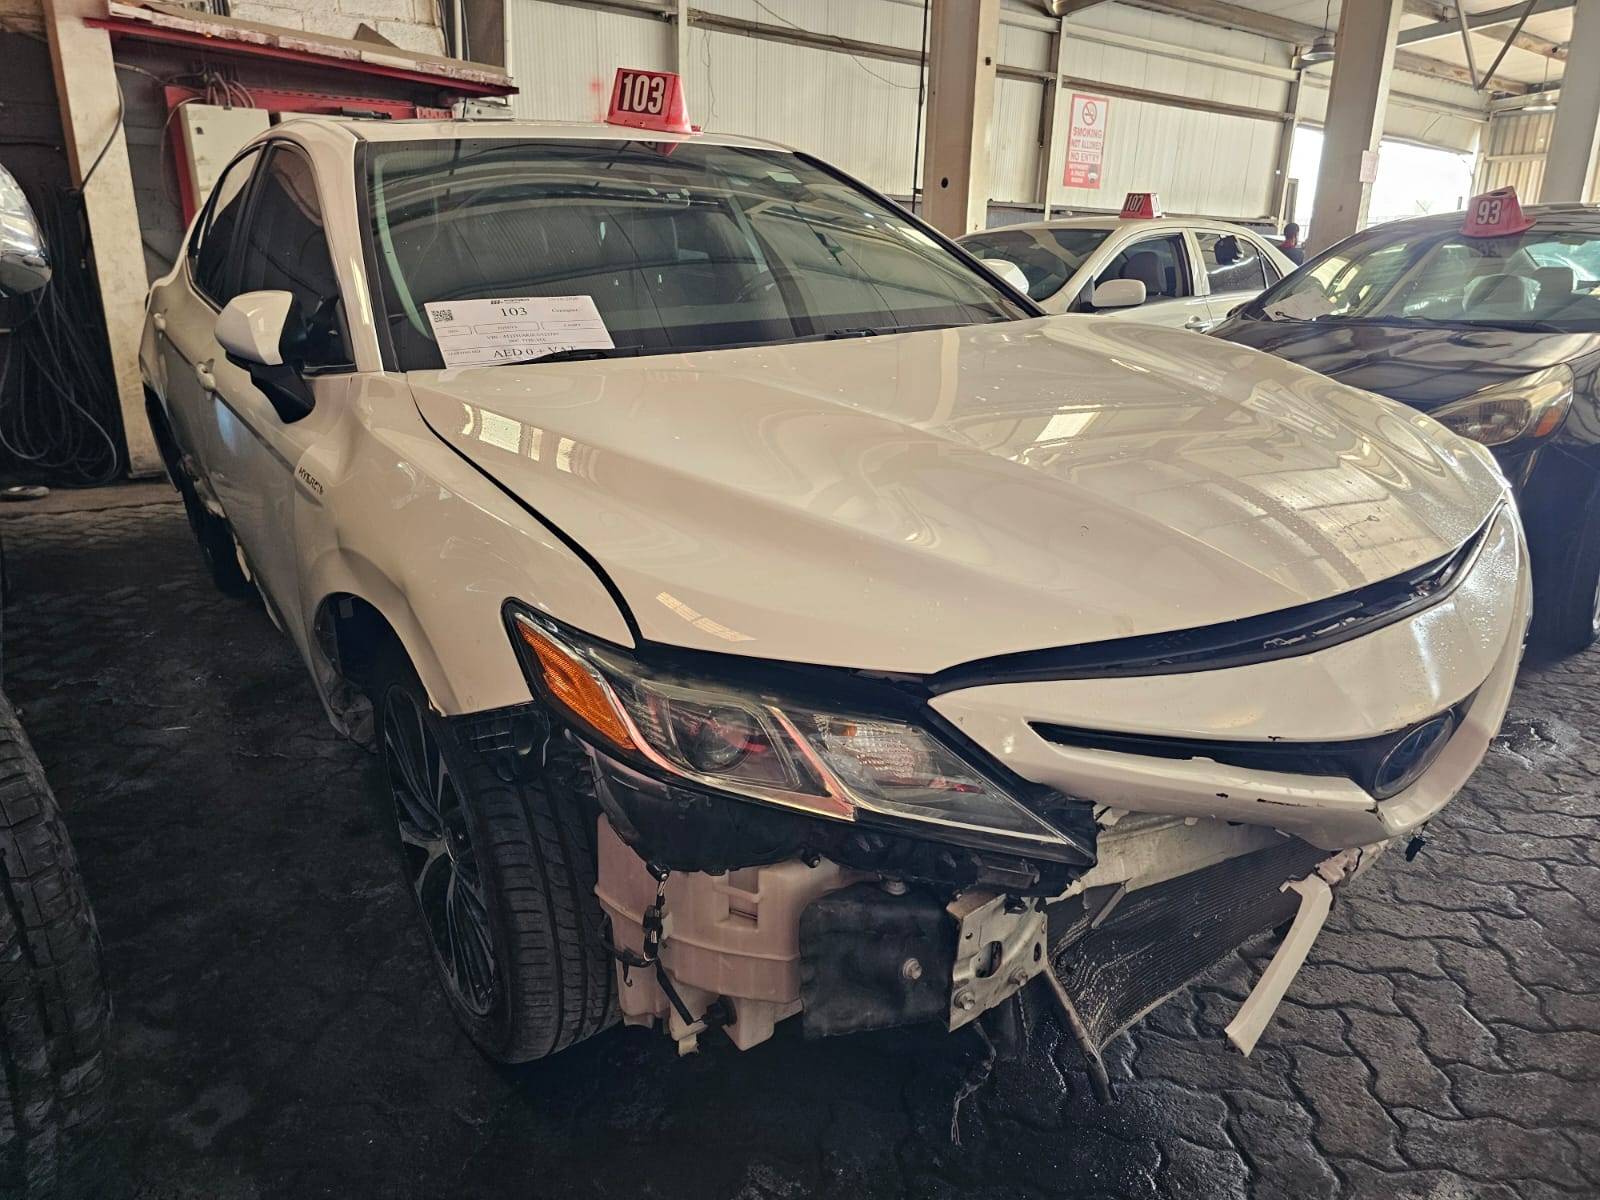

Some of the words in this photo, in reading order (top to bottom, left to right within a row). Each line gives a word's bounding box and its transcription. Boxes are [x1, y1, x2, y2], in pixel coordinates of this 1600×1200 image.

[622, 73, 665, 114] 103
[1073, 127, 1103, 139] SMOKING
[1071, 139, 1081, 150] NOT
[1071, 151, 1080, 161] NO
[1081, 152, 1100, 162] ENTRY
[1126, 194, 1145, 212] 107
[1477, 200, 1502, 225] 93
[501, 307, 528, 317] 103
[493, 348, 522, 358] AED
